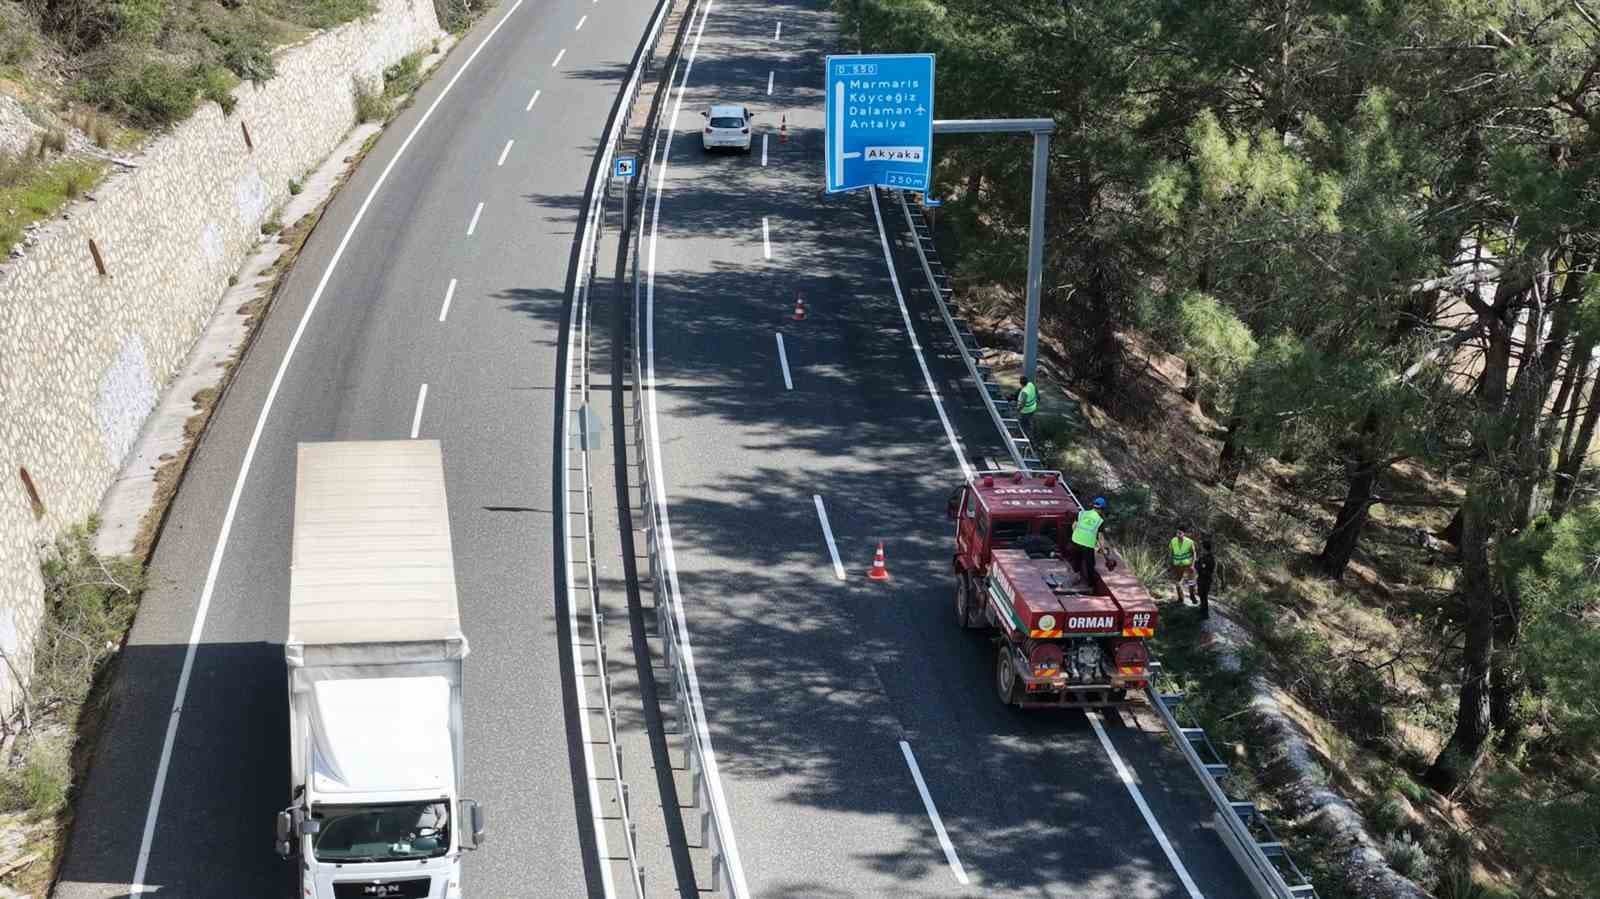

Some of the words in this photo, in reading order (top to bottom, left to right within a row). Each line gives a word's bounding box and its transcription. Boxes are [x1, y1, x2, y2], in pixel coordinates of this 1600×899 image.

[849, 79, 919, 89] Marmaris
[849, 105, 912, 116] Dalaman
[850, 120, 906, 130] Antalya
[868, 149, 920, 160] Akyaka
[993, 487, 1054, 495] ORMAN
[1068, 616, 1114, 629] ORMAN
[364, 884, 399, 894] MAN
